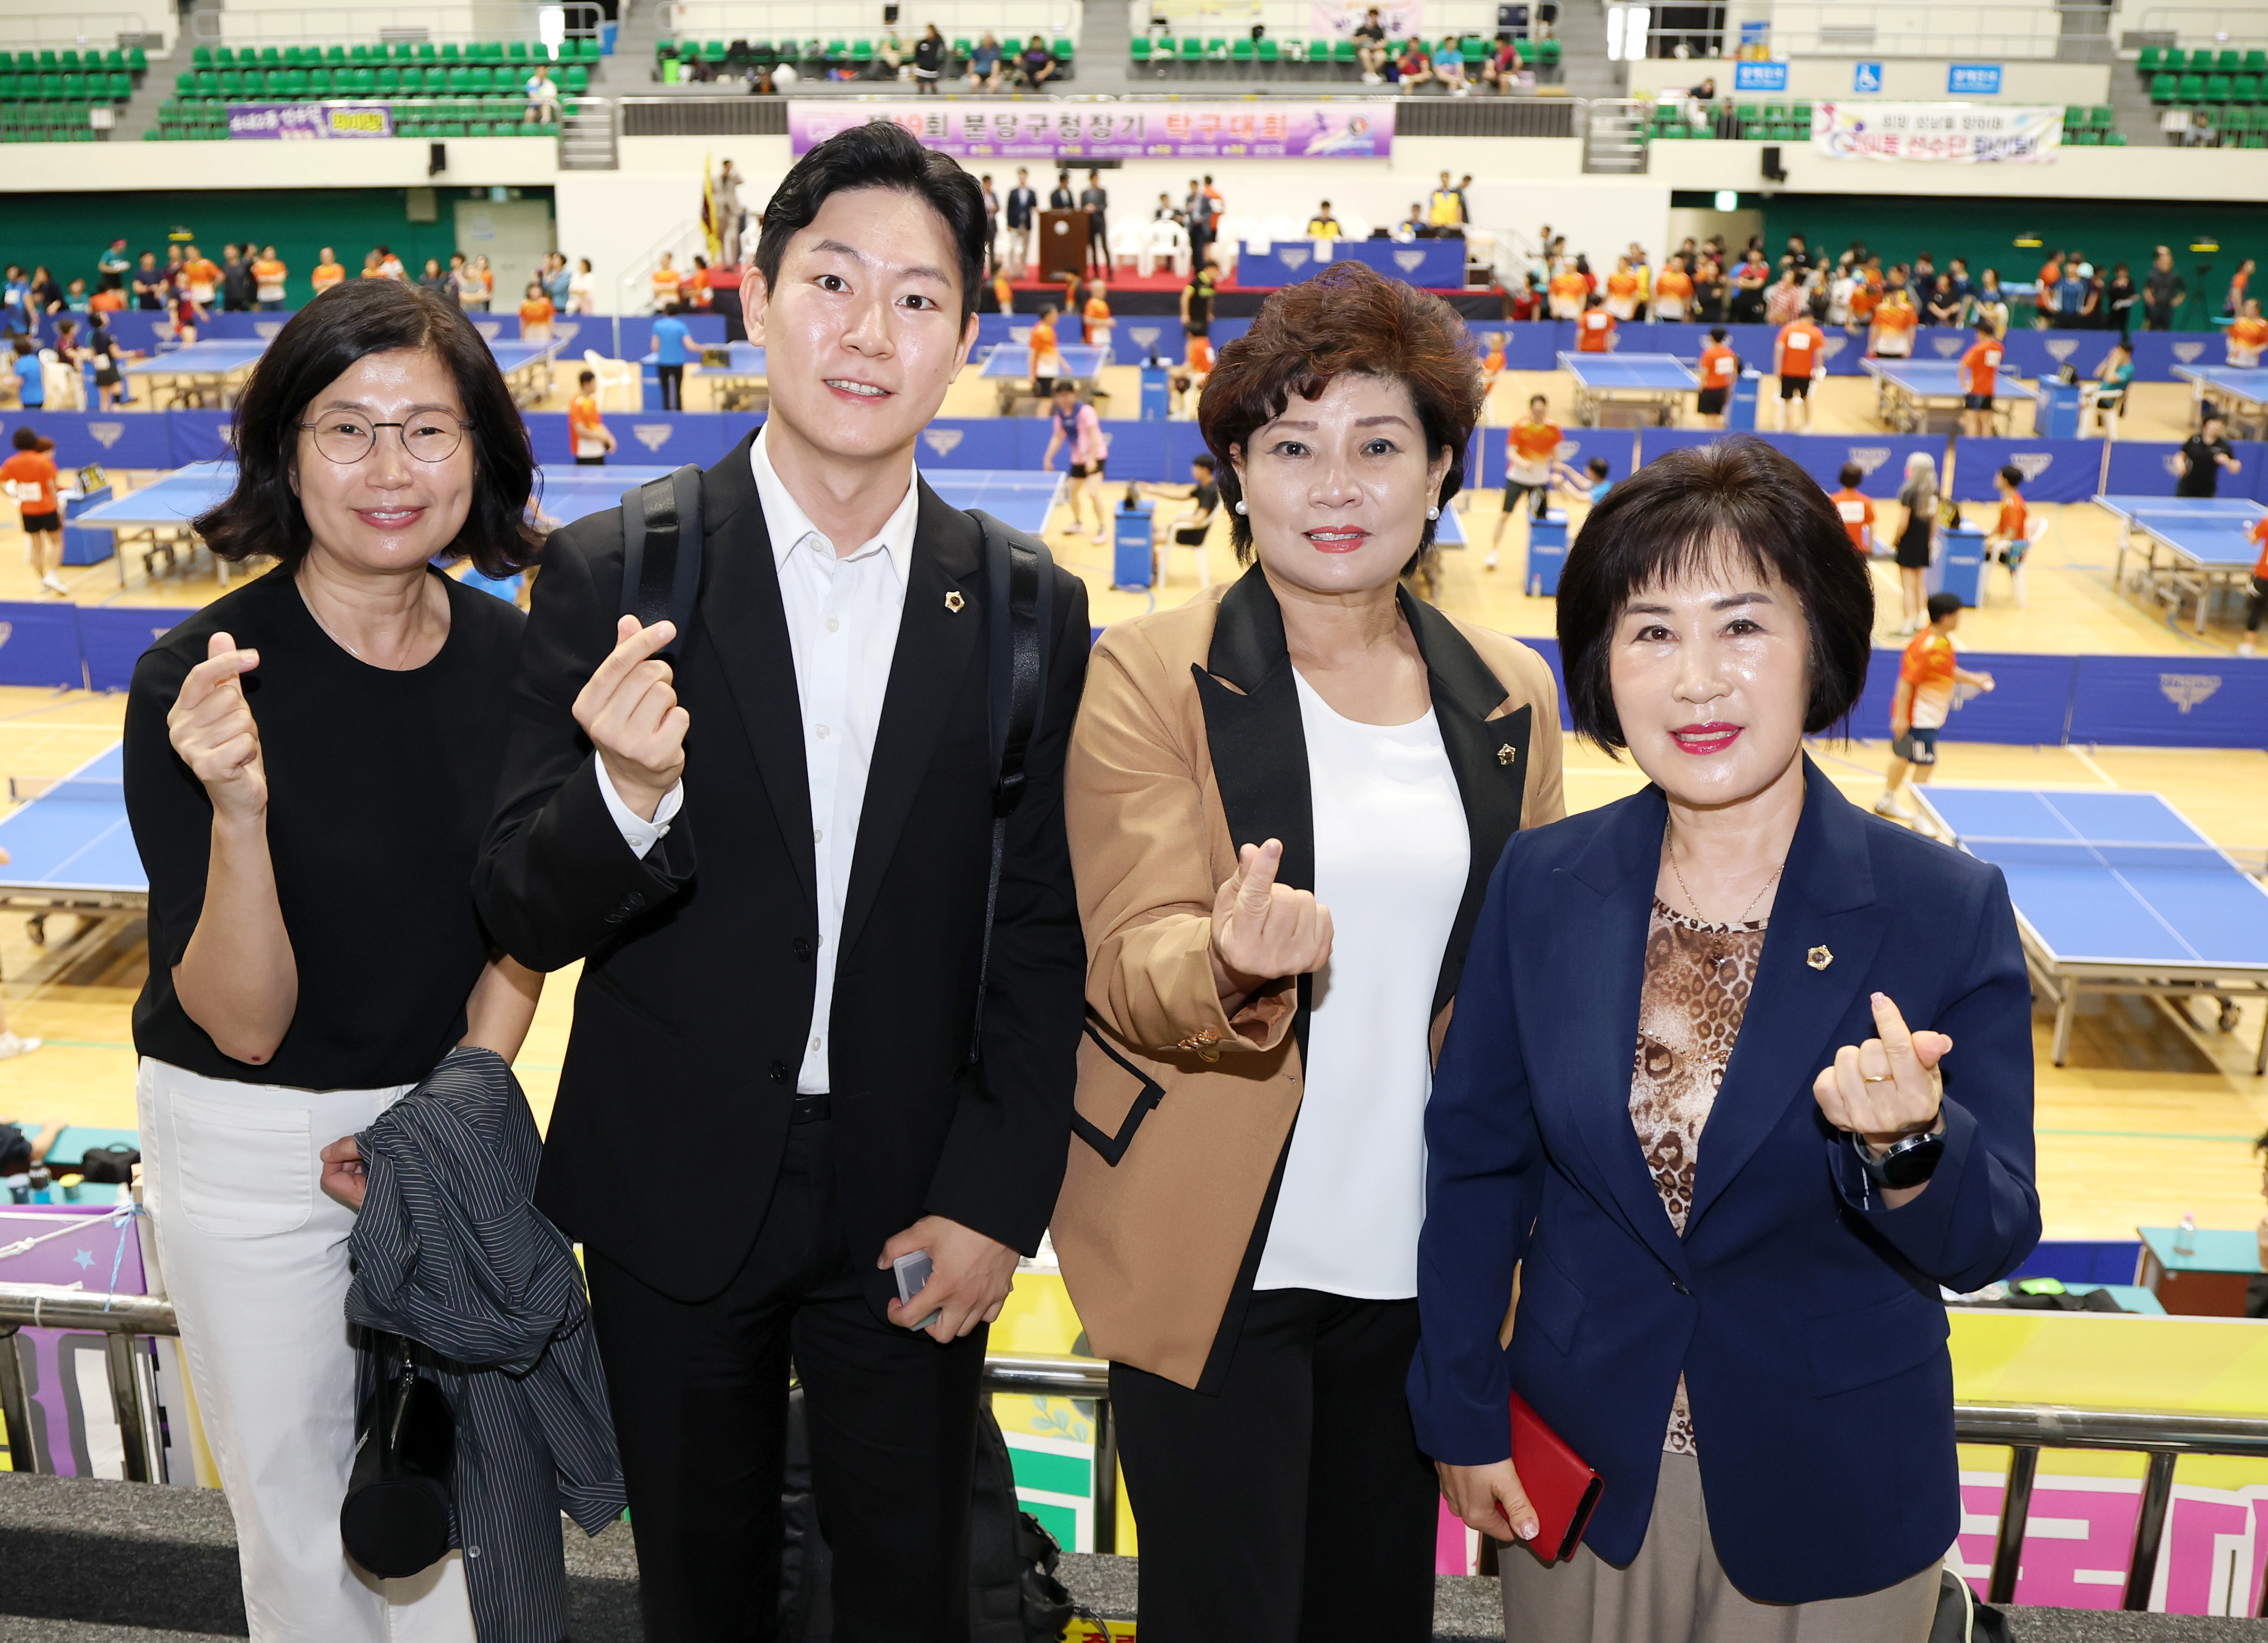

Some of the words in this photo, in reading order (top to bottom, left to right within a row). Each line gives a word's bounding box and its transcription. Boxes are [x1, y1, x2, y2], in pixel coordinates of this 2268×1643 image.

[867, 113, 948, 140] 9회
[963, 113, 1145, 140] 분당구청장기
[1167, 114, 1288, 140] 탁구대회
